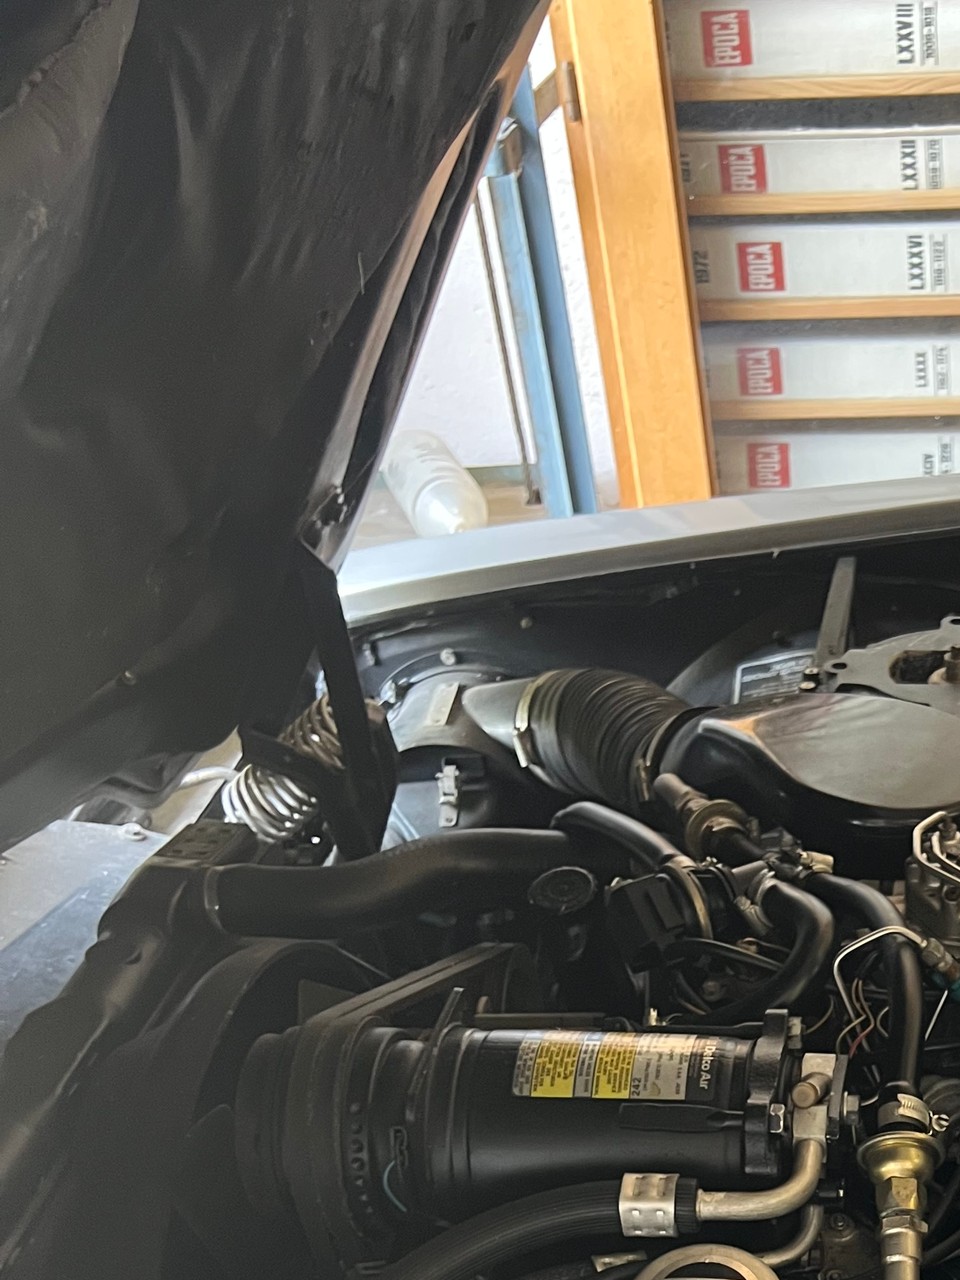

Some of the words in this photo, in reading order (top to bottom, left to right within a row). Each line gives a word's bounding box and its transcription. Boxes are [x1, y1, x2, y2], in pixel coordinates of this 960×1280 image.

[710, 12, 742, 66] EPOCA
[731, 144, 757, 193] EPOCA
[746, 243, 776, 291] EPOCA
[907, 235, 925, 291] LXXXVI
[749, 350, 773, 395] EPOCA
[754, 445, 780, 487] EPOCA
[631, 1077, 642, 1097] 242
[700, 1071, 711, 1090] Air
